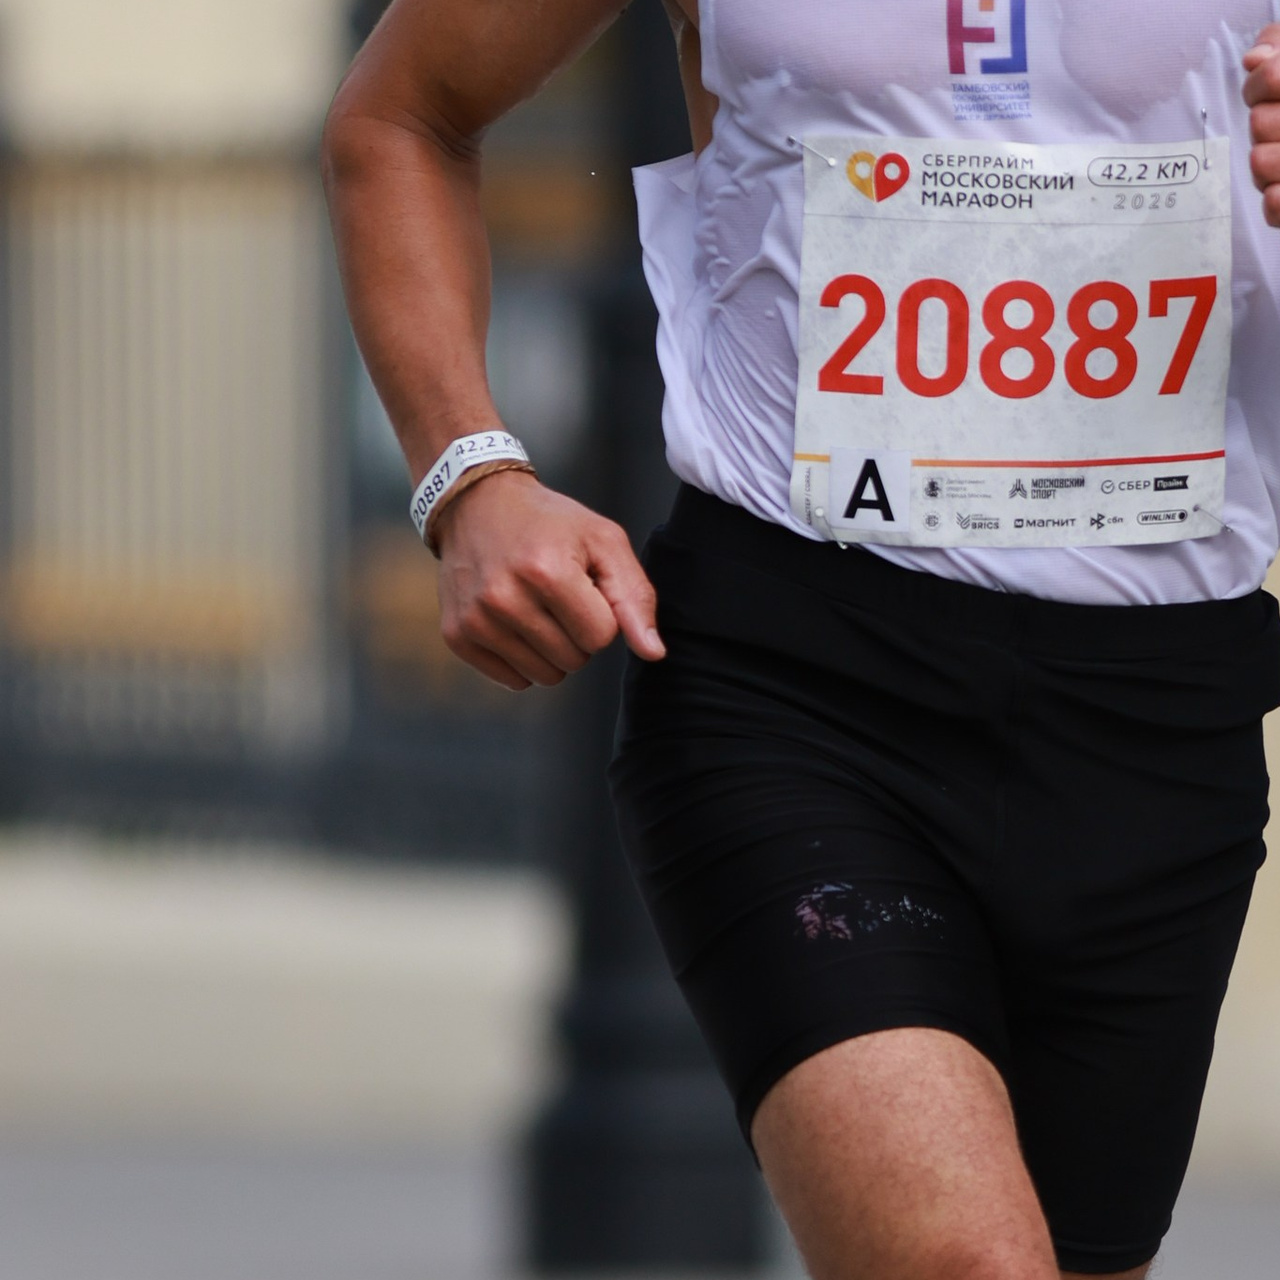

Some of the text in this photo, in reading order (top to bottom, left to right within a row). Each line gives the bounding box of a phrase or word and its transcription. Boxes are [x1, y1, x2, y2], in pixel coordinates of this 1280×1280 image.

[951, 81, 1030, 93] ТАМБОВСКИЙ
[953, 102, 1030, 112] УНИВЕРСИТЕТ
[922, 153, 1035, 170] СБЕРПРАЙМ
[1101, 163, 1149, 183] 42,2
[921, 170, 1075, 191] МОСКОВСКИЙ
[920, 190, 1034, 209] МАРАФОН
[818, 273, 1218, 399] 20887
[413, 461, 451, 527] 20887
[455, 435, 496, 456] 42,2
[1031, 477, 1086, 490] МОСКОВСКИЙ
[1118, 479, 1184, 491] СБЕР Прайм
[1031, 489, 1057, 500] СПОРТ
[1141, 513, 1178, 522] WINLINE
[971, 521, 1000, 529] BRICS
